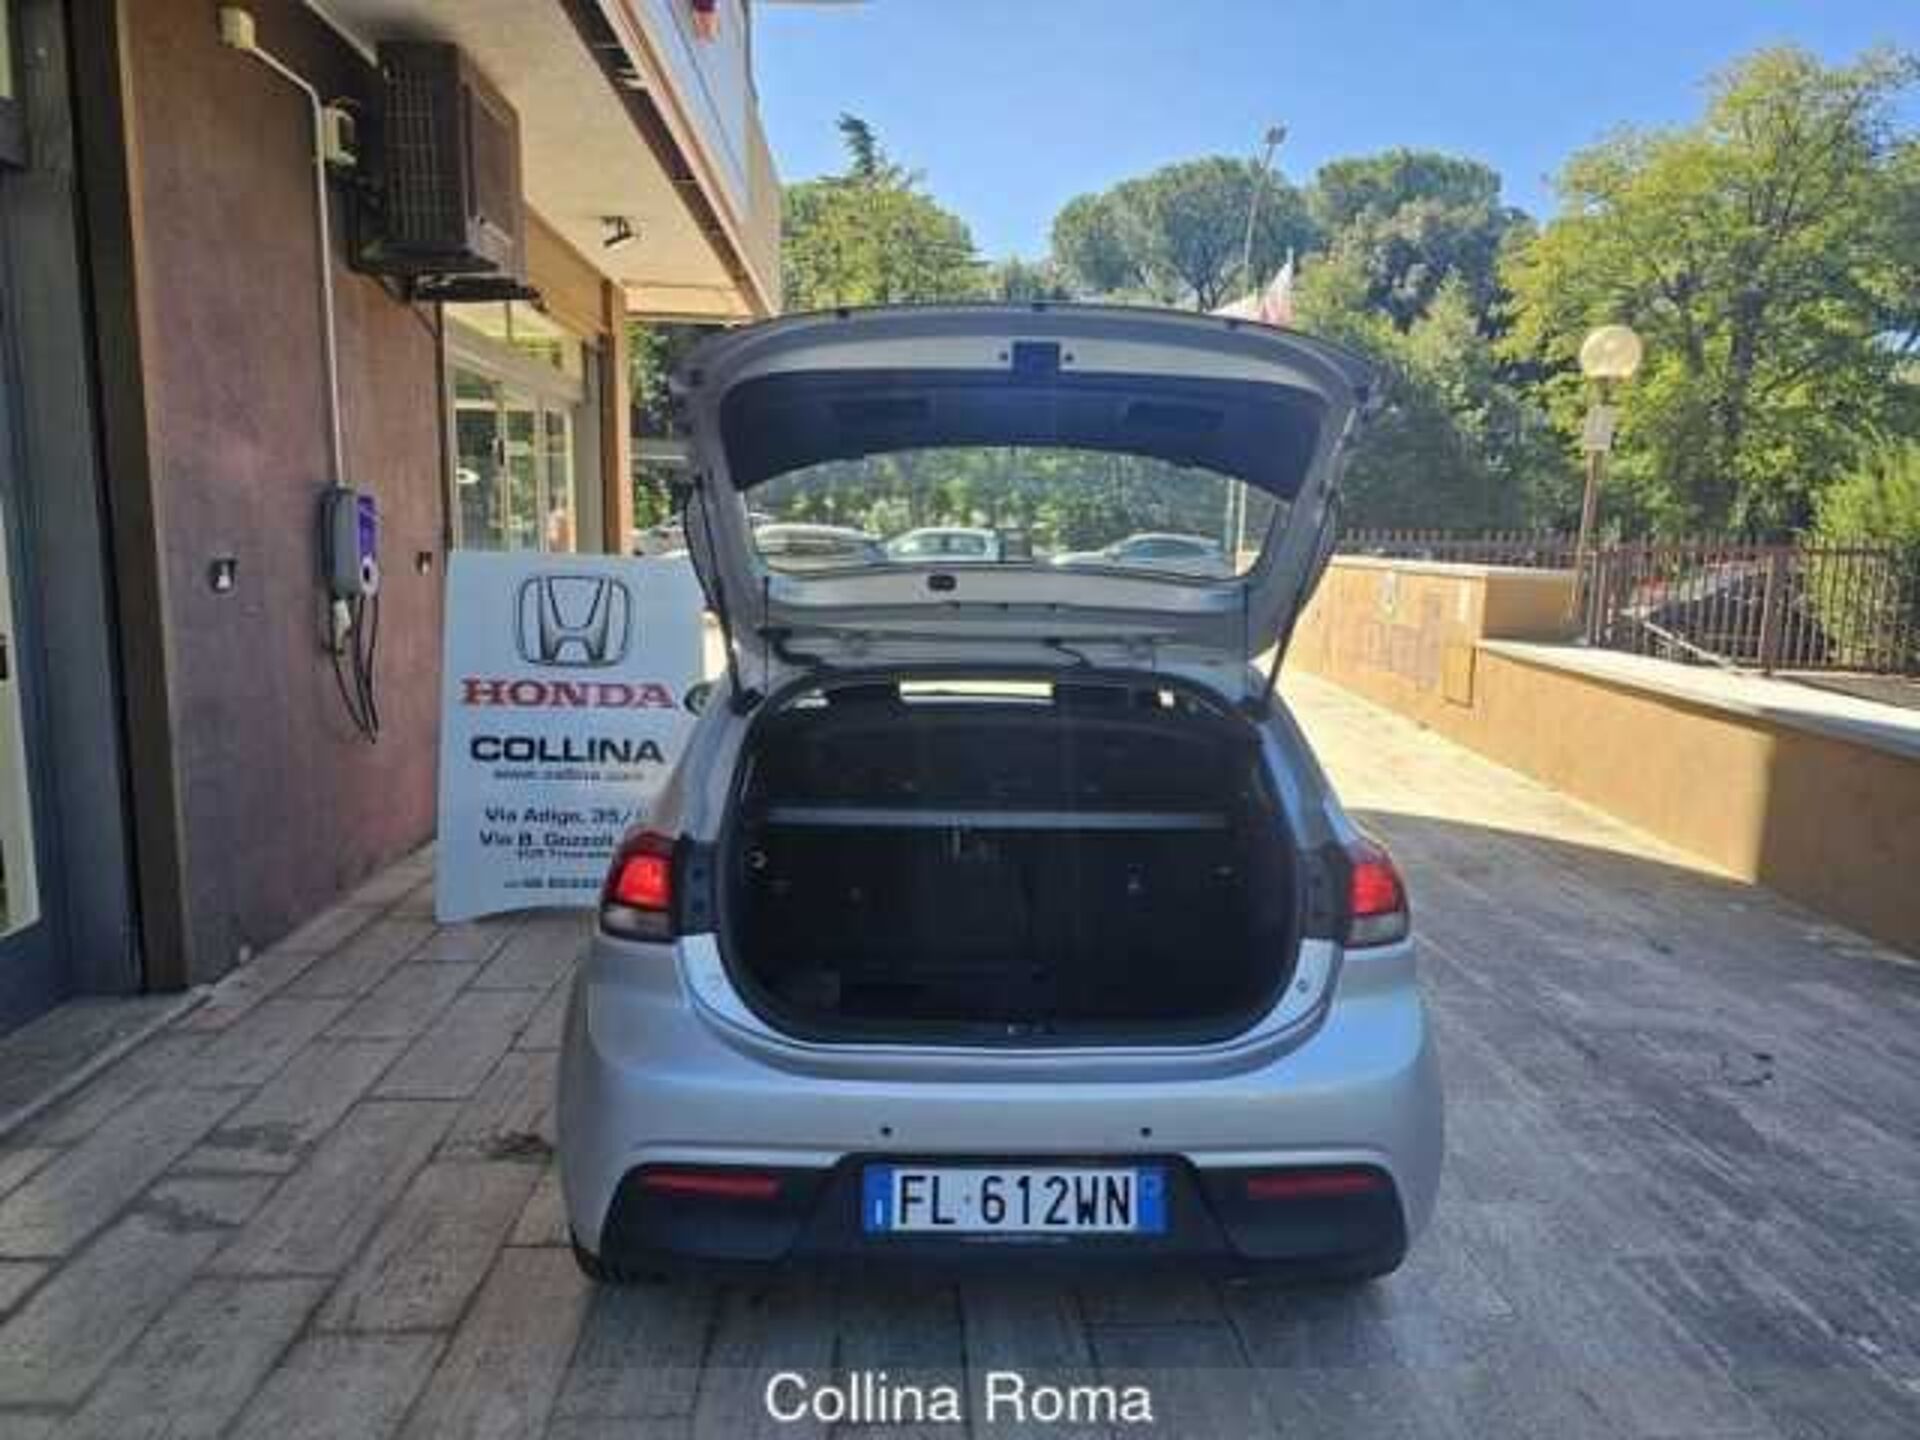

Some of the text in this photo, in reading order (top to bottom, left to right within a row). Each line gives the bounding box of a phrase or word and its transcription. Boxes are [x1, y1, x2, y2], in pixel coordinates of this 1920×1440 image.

[462, 678, 677, 708] HONDA
[470, 735, 664, 763] COLLINA
[899, 1175, 956, 1225] FL
[980, 1175, 1131, 1225] 612WN
